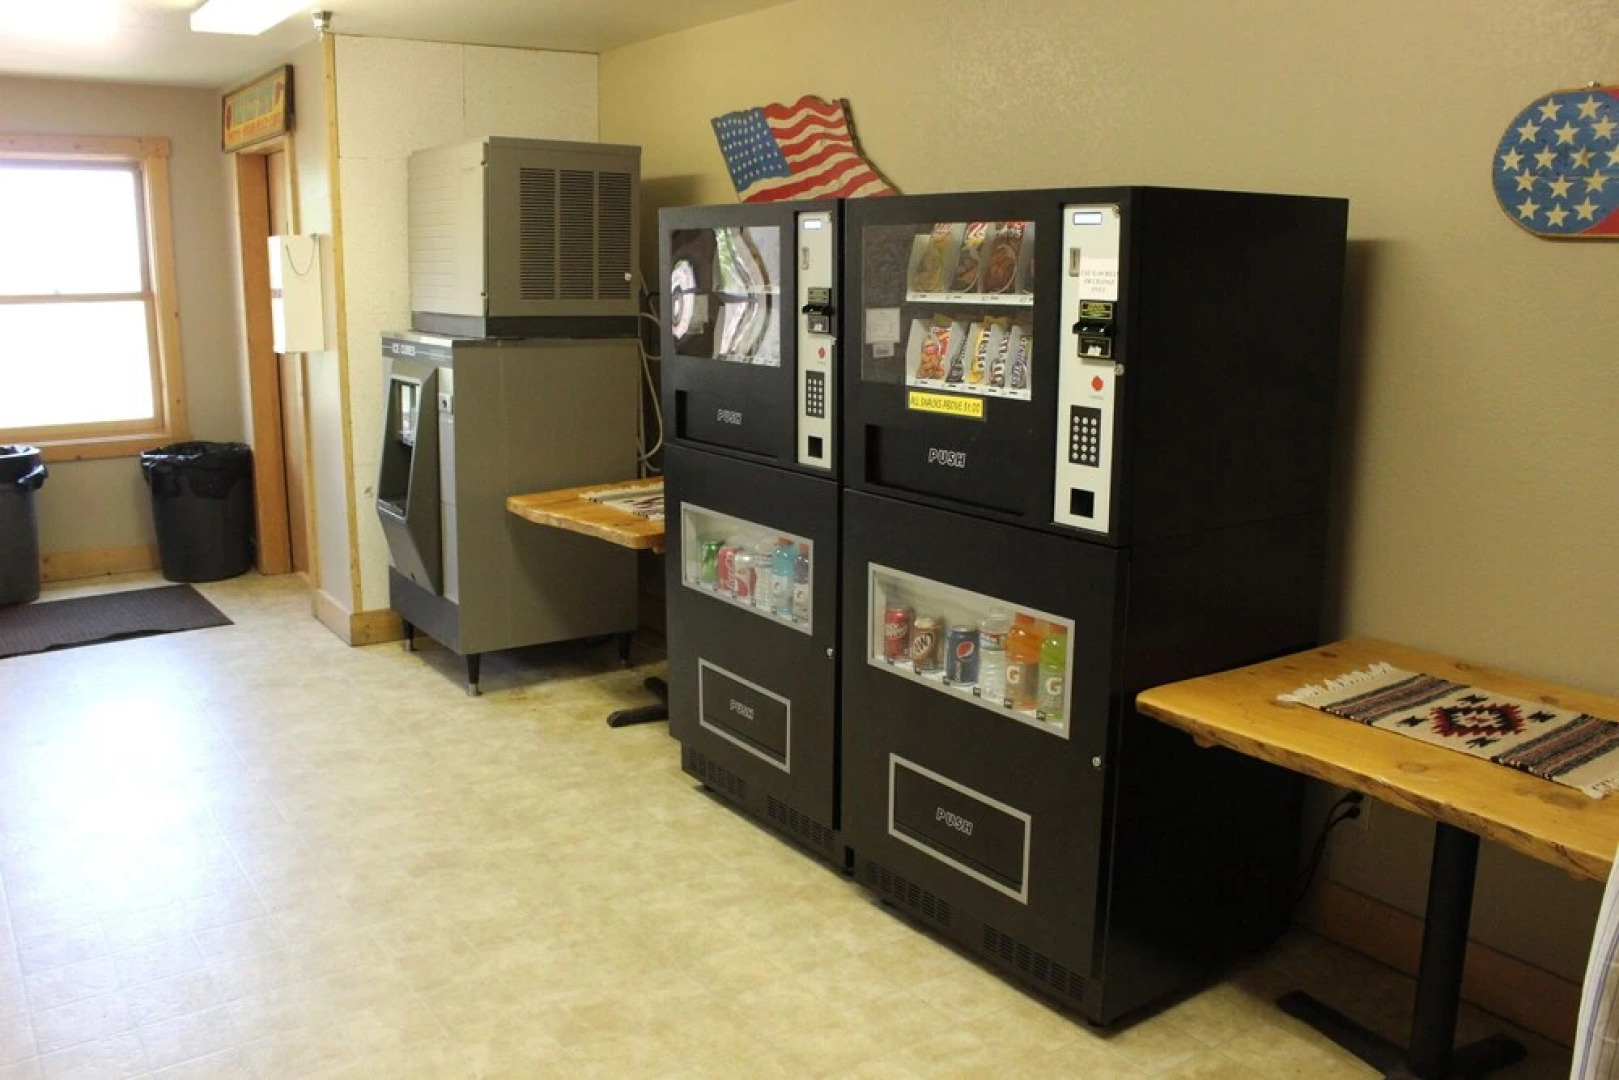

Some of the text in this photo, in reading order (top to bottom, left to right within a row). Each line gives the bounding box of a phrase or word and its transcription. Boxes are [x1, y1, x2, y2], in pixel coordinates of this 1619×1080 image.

[910, 395, 919, 406] ALL
[920, 397, 941, 409] SNACKS
[717, 408, 743, 425] PUSH
[928, 447, 966, 468] PUSH
[1006, 666, 1020, 684] G
[1045, 676, 1062, 696] G
[730, 698, 754, 720] PUSH
[936, 807, 973, 836] PUSH
